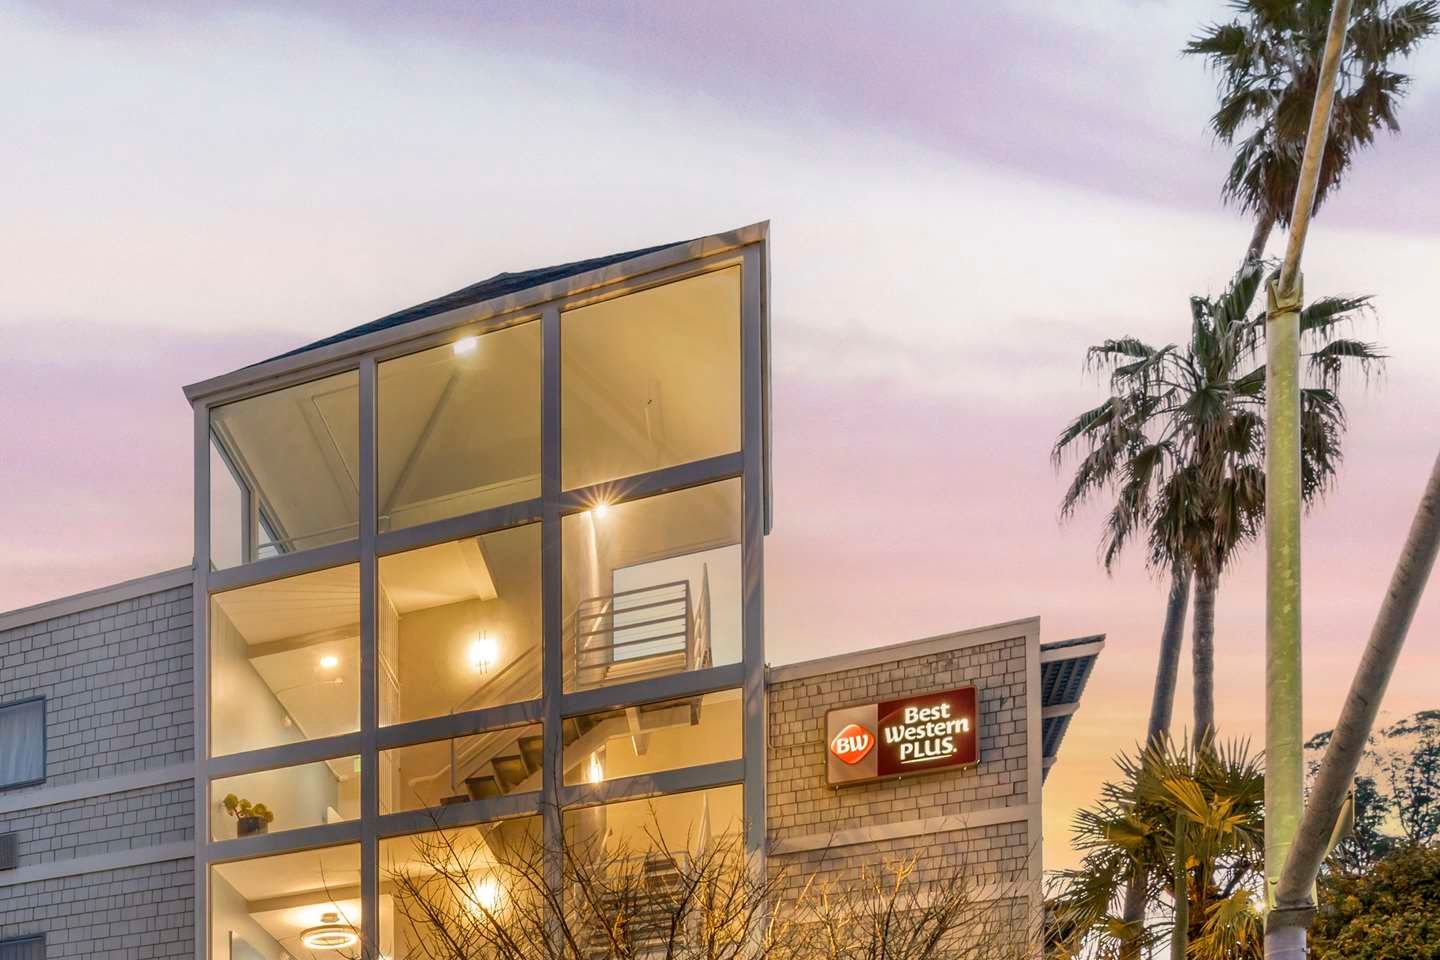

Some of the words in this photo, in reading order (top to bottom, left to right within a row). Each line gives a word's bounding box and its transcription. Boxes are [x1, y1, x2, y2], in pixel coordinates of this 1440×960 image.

[904, 702, 951, 724] Best
[884, 717, 970, 744] Western
[836, 734, 869, 754] BW
